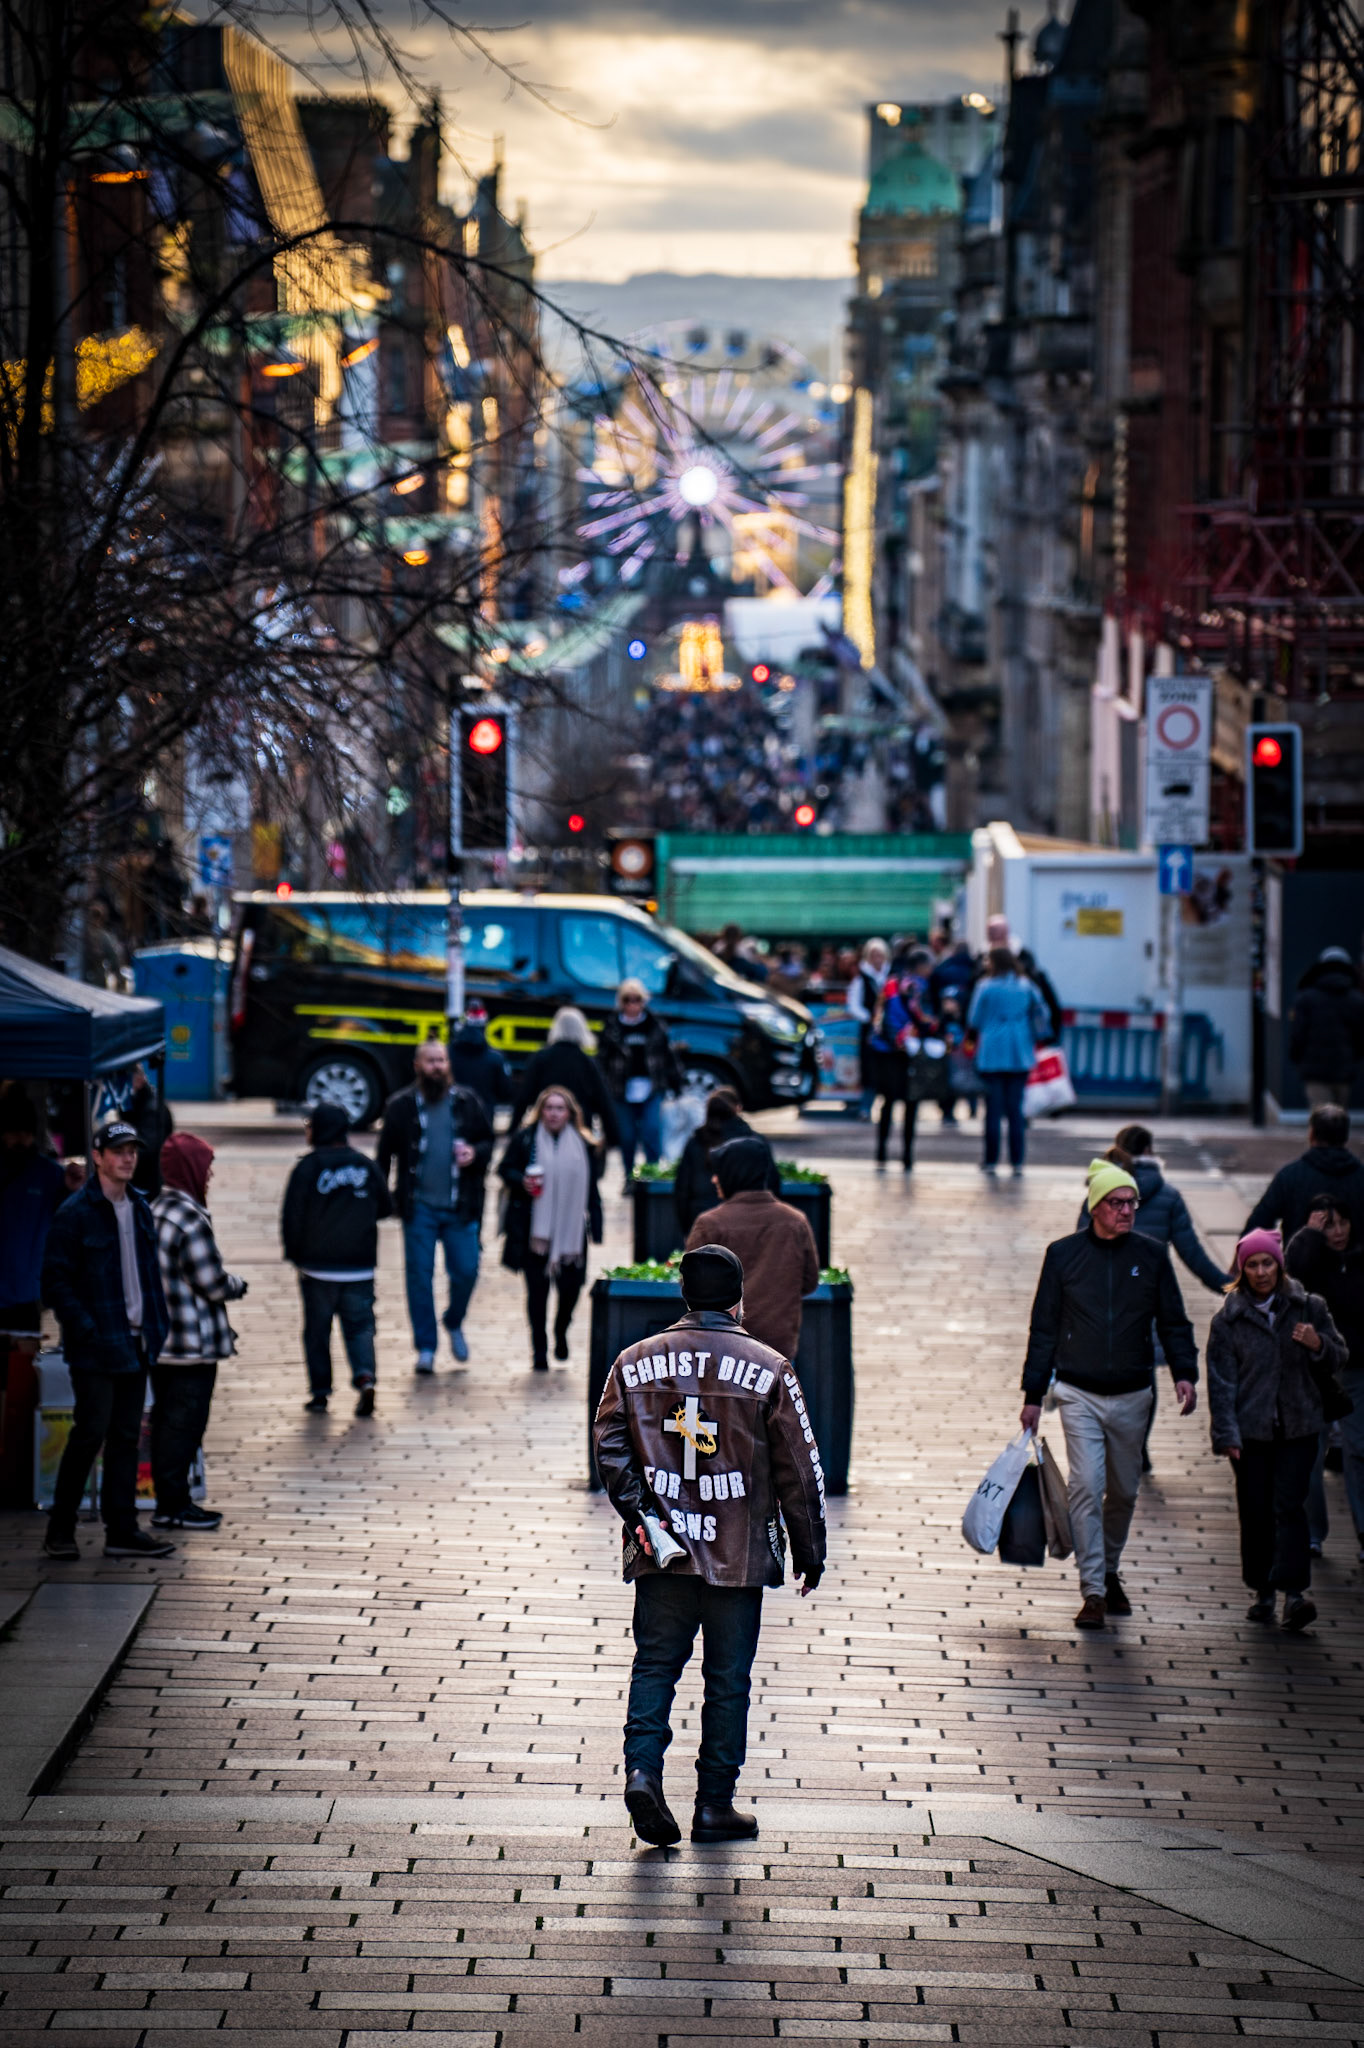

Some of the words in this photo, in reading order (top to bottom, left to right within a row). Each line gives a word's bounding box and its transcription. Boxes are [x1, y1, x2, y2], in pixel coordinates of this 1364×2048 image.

[621, 1351, 711, 1388] CHRIST
[717, 1355, 775, 1395] DIED
[783, 1372, 815, 1444] JESUS
[643, 1465, 682, 1501] FOR
[698, 1471, 747, 1502] OUR
